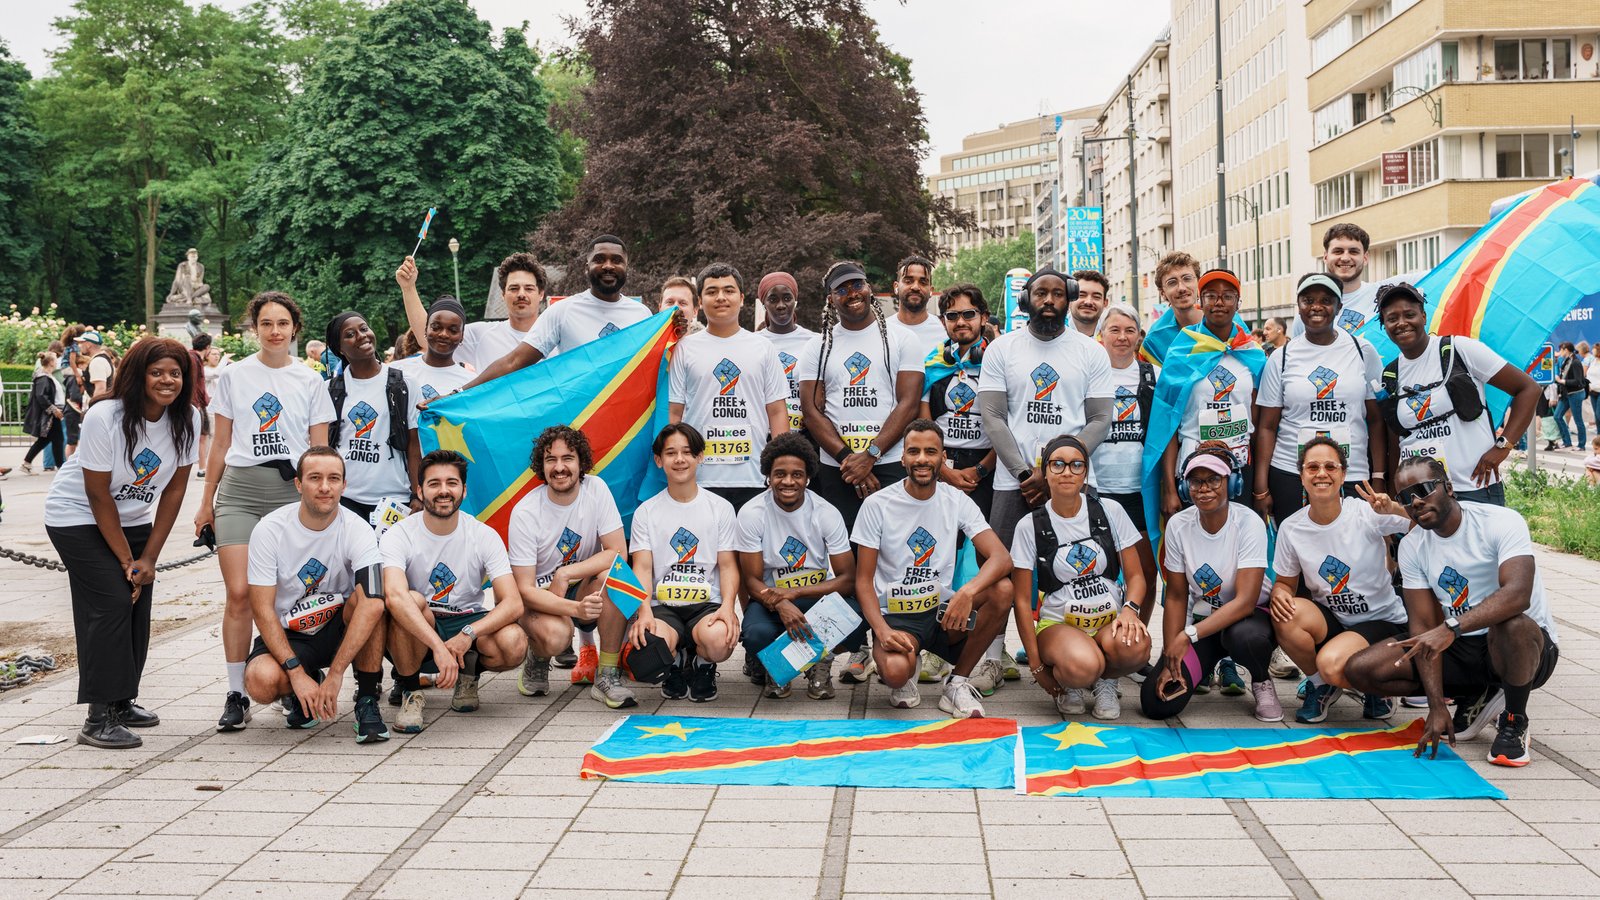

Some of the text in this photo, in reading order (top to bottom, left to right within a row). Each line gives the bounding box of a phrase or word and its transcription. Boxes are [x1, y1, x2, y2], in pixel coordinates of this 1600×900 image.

[1069, 209, 1086, 220] 20
[1069, 230, 1100, 238] 31/05/26
[843, 387, 868, 397] FREE
[713, 397, 737, 407] FREE
[843, 397, 878, 407] CONGO
[1027, 401, 1053, 413] FREE
[1310, 401, 1337, 411] FREE
[713, 408, 747, 418] CONGO
[1027, 412, 1062, 425] CONGO
[1310, 411, 1346, 422] CONGO
[841, 423, 880, 435] pluxee
[948, 418, 972, 429] FREE
[1208, 421, 1247, 438] 62756
[707, 428, 746, 439] pluxee
[947, 428, 981, 440] CONGO
[1416, 425, 1451, 439] CONGO
[252, 432, 282, 445] FREE
[253, 443, 290, 456] CONGO
[349, 439, 371, 451] FREE
[712, 442, 750, 453] 13763
[345, 449, 380, 463] CONGO
[662, 572, 705, 584] pluxee
[906, 567, 931, 579] FREE
[785, 572, 825, 589] 13762
[667, 588, 707, 600] 13773
[891, 584, 935, 598] pluxee
[1074, 582, 1109, 600] CONGO
[289, 592, 335, 617] pluxee
[898, 595, 938, 611] 13765
[1326, 594, 1355, 606] FREE
[1070, 601, 1111, 614] pluxee
[1075, 614, 1114, 628] 13771
